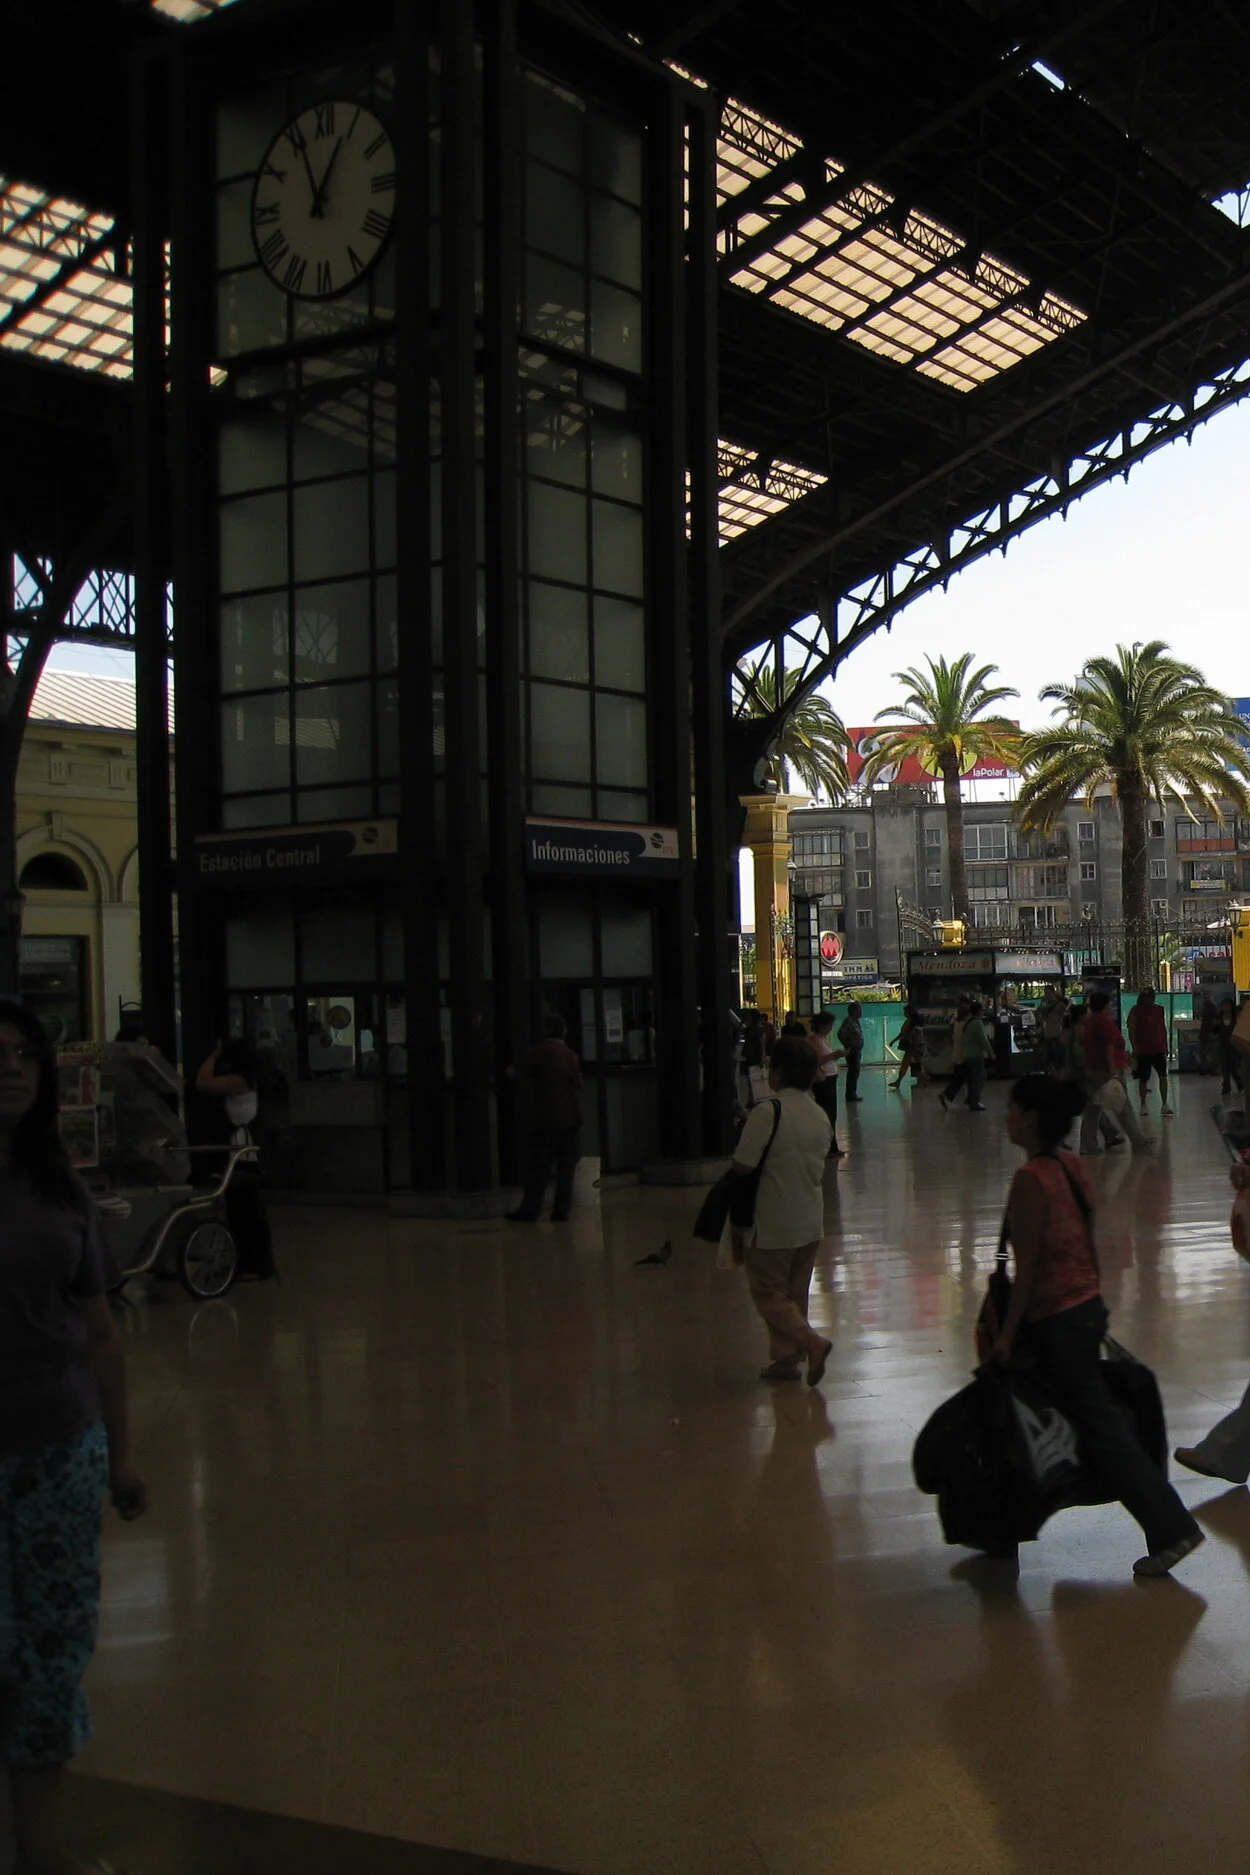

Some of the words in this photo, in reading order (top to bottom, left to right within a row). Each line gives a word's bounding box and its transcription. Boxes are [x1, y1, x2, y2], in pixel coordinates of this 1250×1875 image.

[198, 848, 262, 873] Estación
[265, 844, 321, 868] Central
[531, 839, 631, 865] Informaciones
